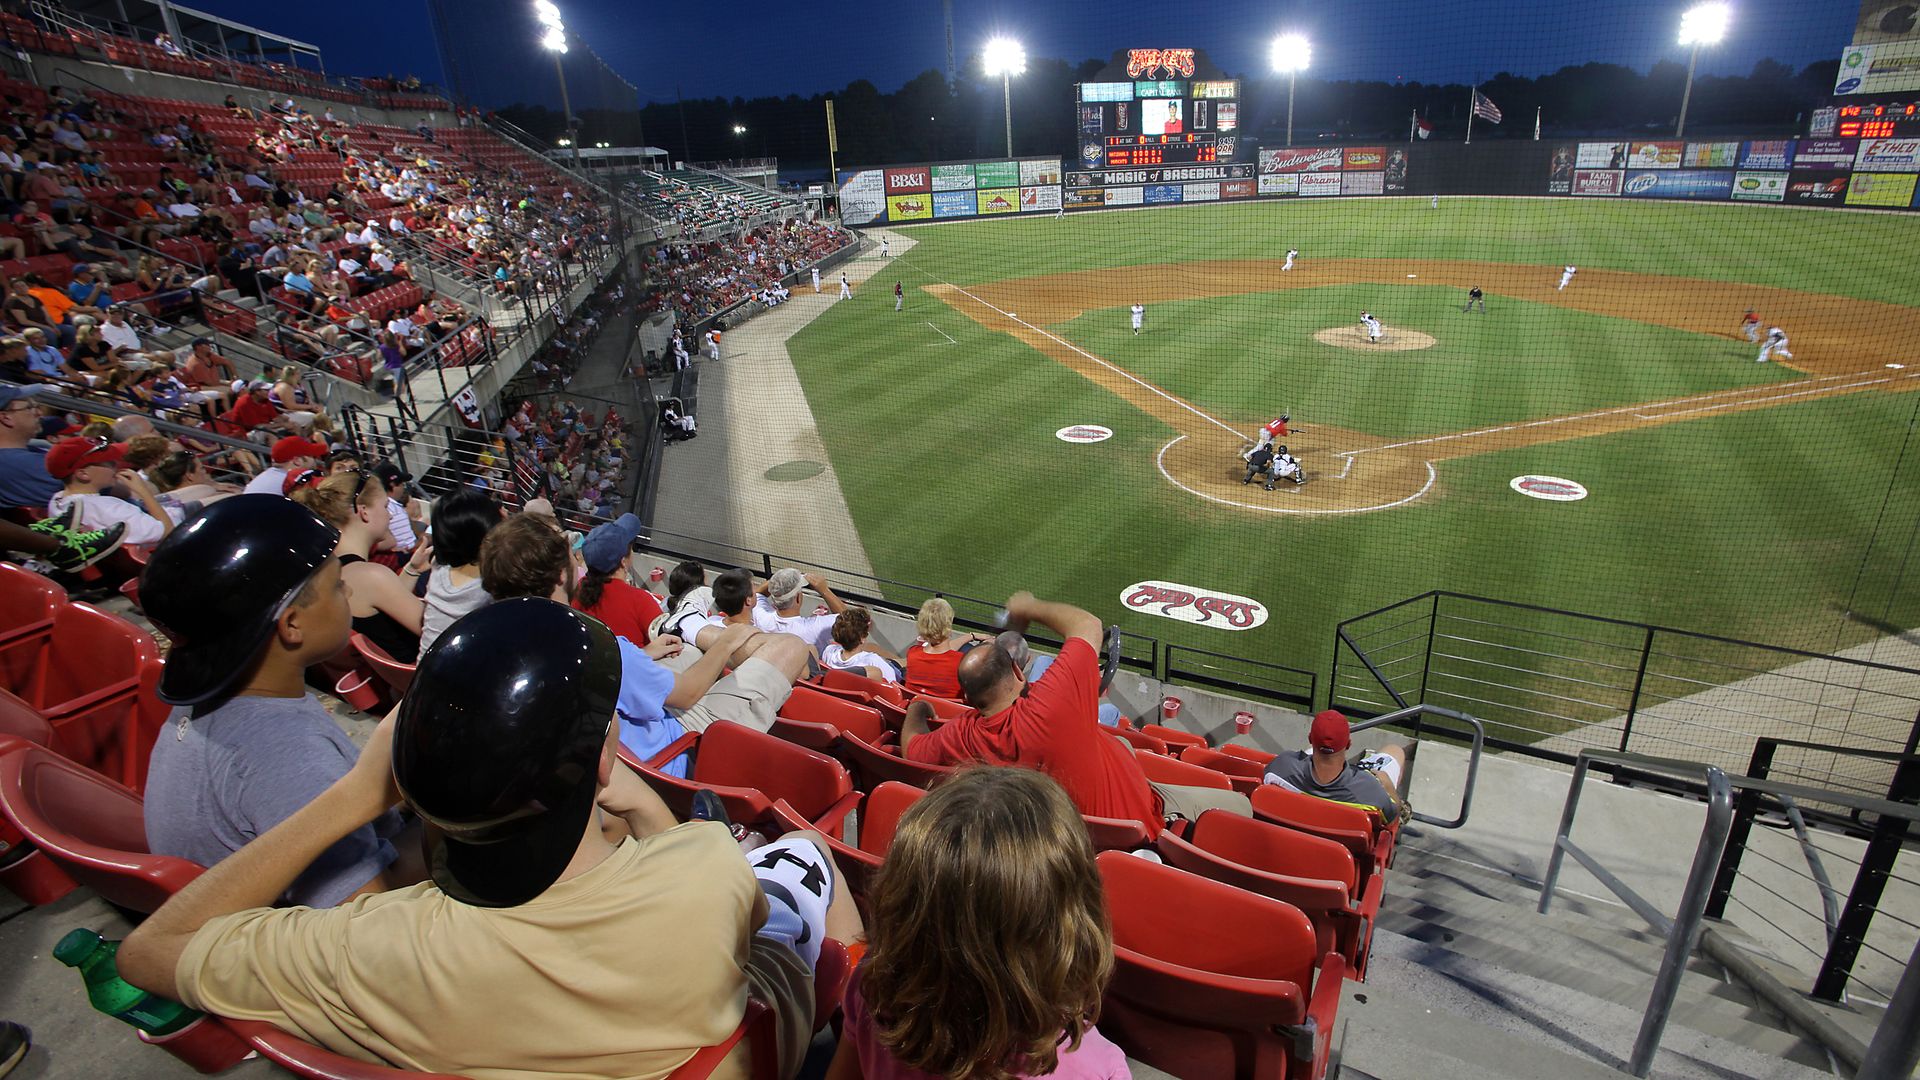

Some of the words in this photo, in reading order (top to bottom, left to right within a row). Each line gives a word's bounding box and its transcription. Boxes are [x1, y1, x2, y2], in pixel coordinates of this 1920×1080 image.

[1875, 106, 1883, 116] 0
[1906, 104, 1915, 115] 0
[1140, 135, 1145, 144] 0
[1161, 134, 1167, 143] 0
[1188, 134, 1193, 142] 0
[1264, 148, 1339, 173] Budweiser
[890, 173, 926, 188] BB&T
[1104, 171, 1147, 184] MAGIC
[1150, 170, 1160, 181] of
[1163, 167, 1227, 181] BASEBALL
[1302, 175, 1341, 185] Abrams
[1580, 179, 1613, 188] BUREAU
[934, 193, 964, 203] Walmart
